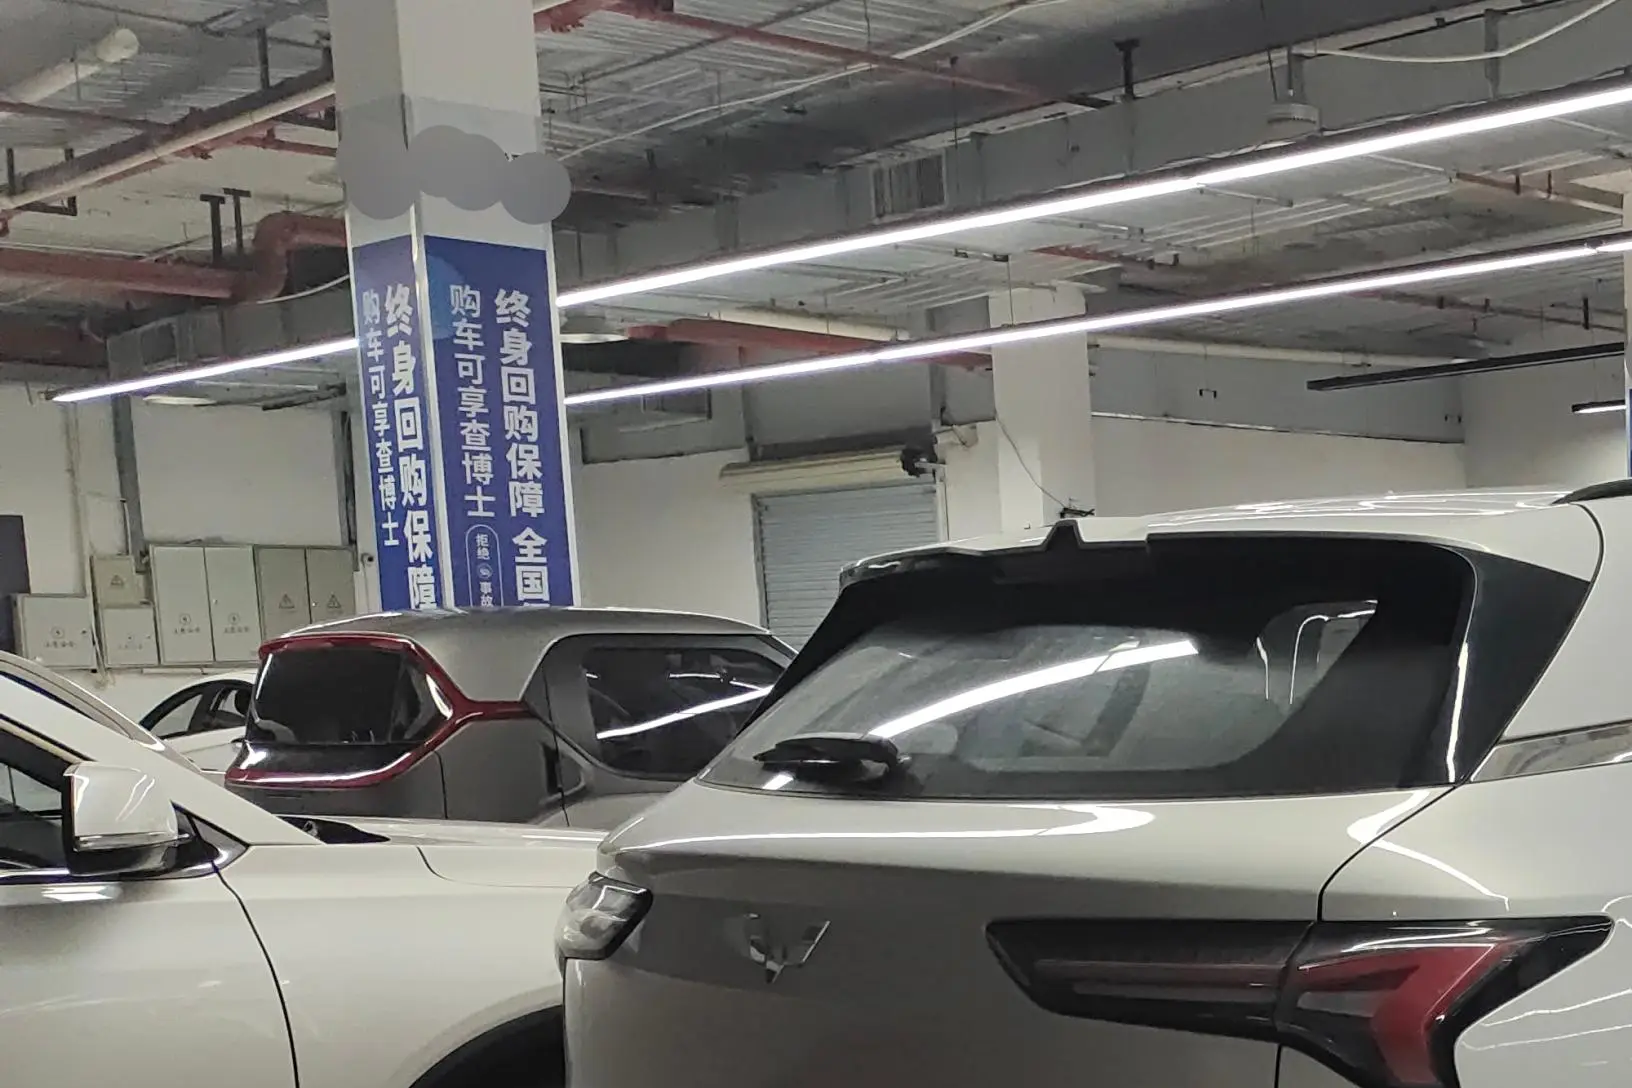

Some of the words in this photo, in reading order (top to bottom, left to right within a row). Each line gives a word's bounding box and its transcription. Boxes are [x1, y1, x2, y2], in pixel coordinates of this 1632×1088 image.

[362, 288, 400, 547] 购车可享查博士
[384, 283, 438, 609] 终身回购保障
[449, 283, 496, 518] 购车可享查博士
[494, 287, 546, 518] 终身回购保障
[512, 526, 550, 607] 全国
